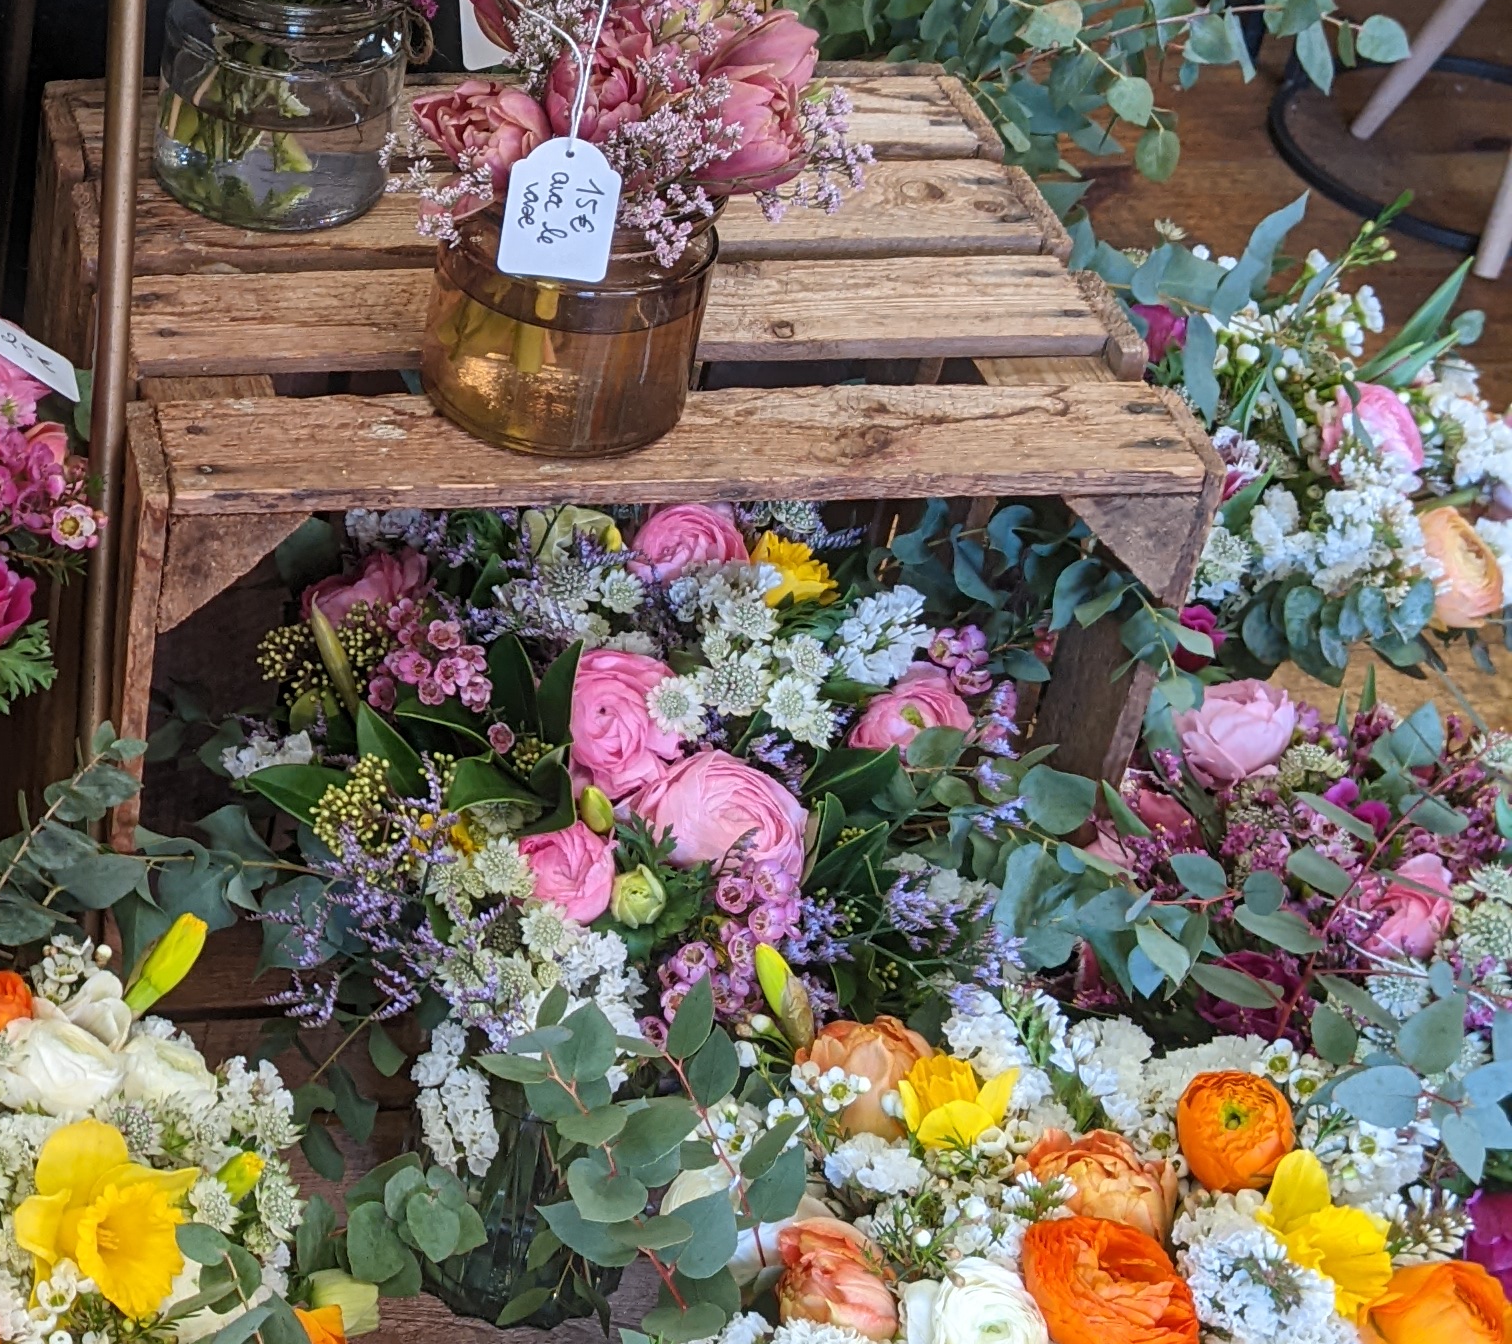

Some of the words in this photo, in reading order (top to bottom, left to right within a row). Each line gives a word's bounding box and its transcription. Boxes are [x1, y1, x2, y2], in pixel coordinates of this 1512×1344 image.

[517, 181, 539, 229] vase
[569, 178, 605, 233] 15€
[536, 221, 568, 245] le
